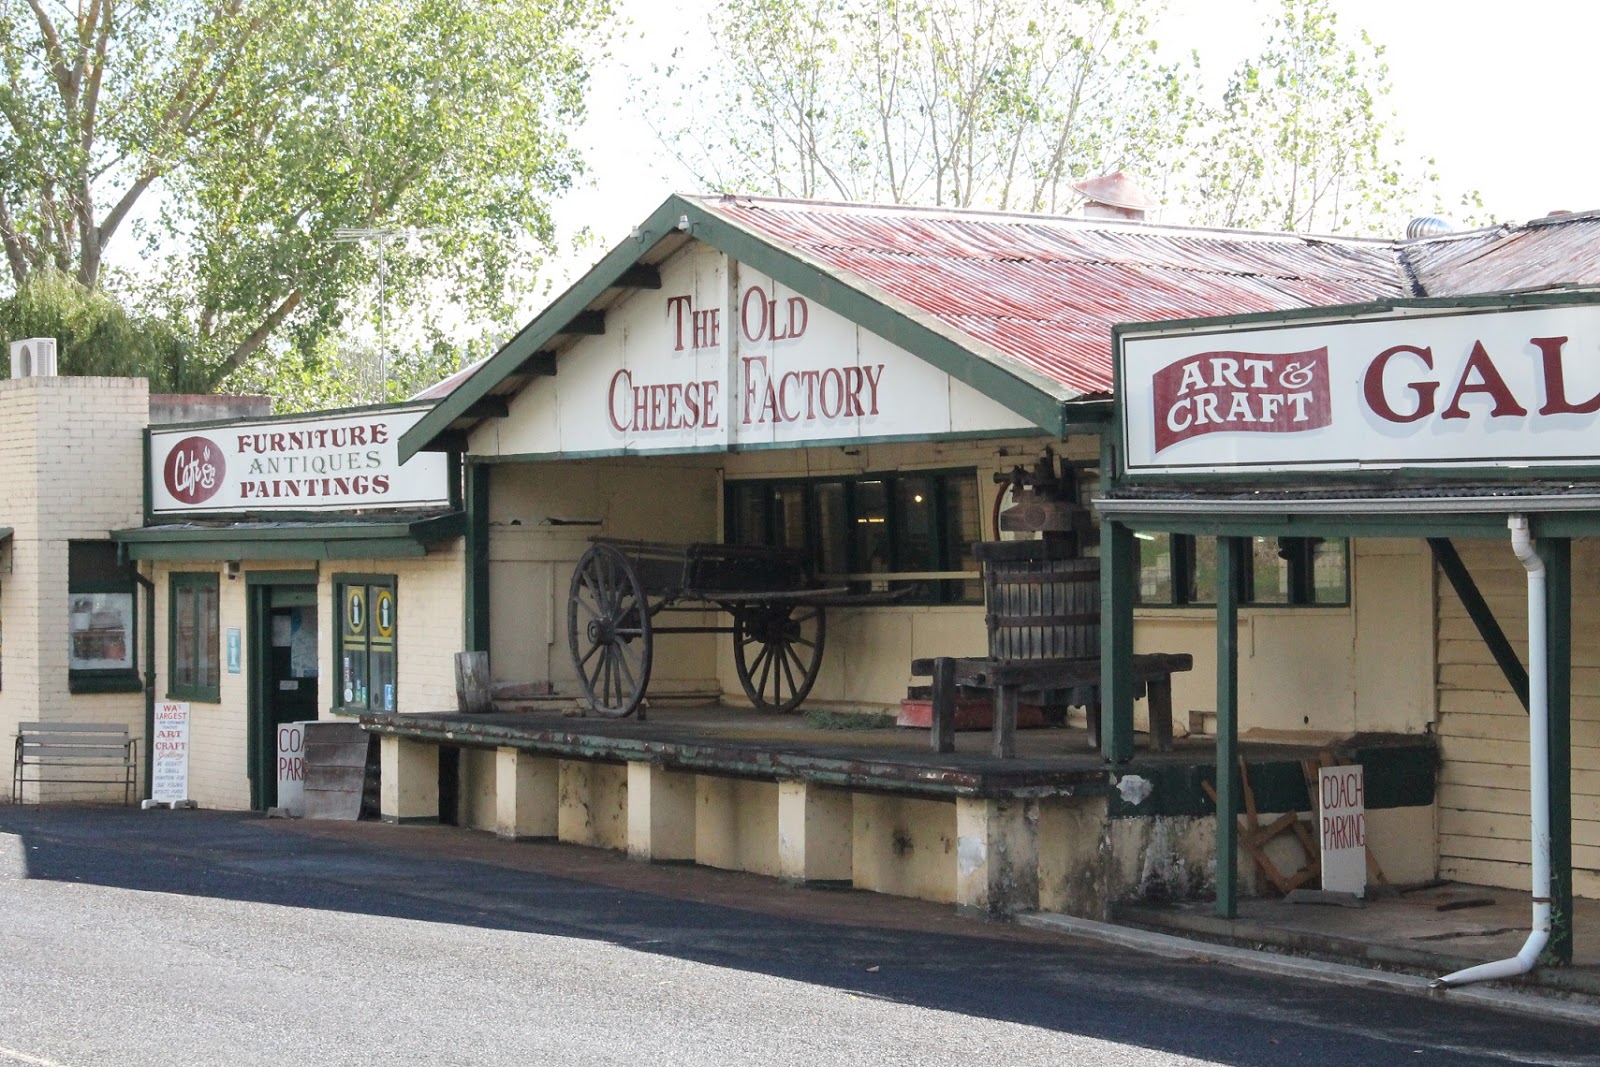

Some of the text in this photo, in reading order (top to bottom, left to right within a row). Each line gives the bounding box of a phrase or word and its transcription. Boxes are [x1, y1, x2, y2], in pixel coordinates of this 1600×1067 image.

[741, 285, 809, 342] OLD
[1177, 357, 1316, 396] ART &
[608, 356, 885, 432] CHEESE FACTORY
[1167, 391, 1313, 432] CRAFT
[237, 423, 389, 454] FURNITURE
[248, 450, 382, 475] ANTIQUES
[240, 474, 390, 498] PAINTINGS
[156, 712, 187, 720] LARGEST
[155, 741, 186, 750] CRAFT
[157, 730, 183, 738] ART
[1322, 773, 1363, 809] COACH
[1323, 814, 1365, 850] PARKING
